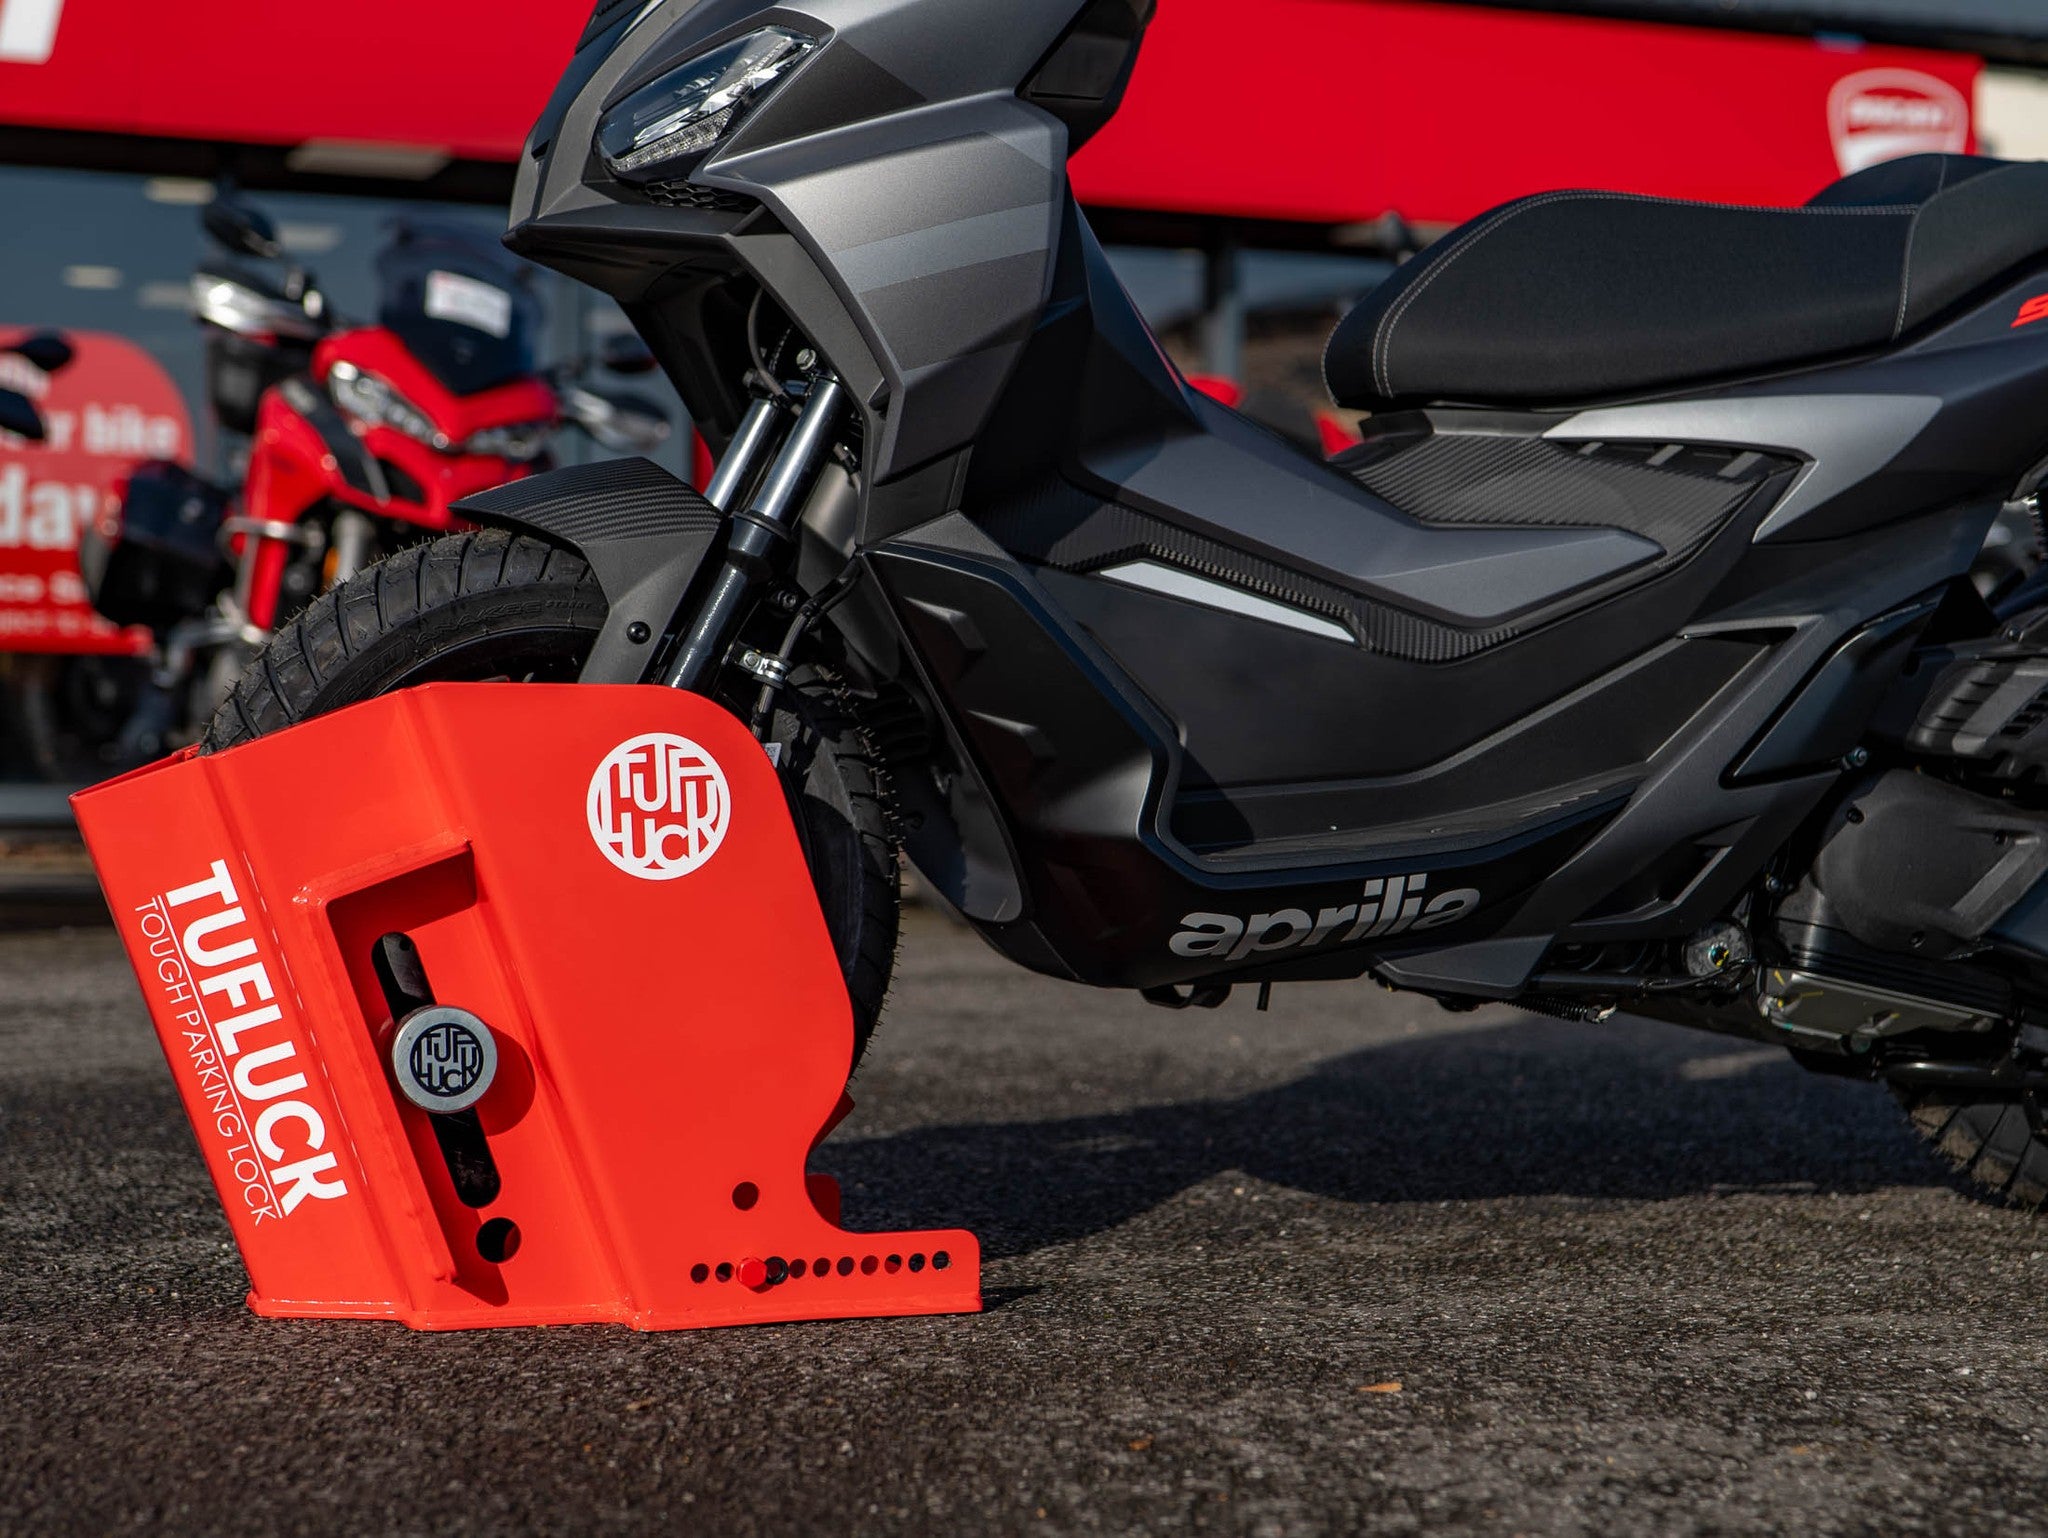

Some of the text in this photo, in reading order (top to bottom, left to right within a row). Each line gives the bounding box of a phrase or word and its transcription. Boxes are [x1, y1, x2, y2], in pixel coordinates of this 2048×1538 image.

[134, 897, 277, 1226] TOUGH PARKING LOCK
[165, 859, 348, 1217] TUFLUCK
[1169, 873, 1481, 961] aprilia
